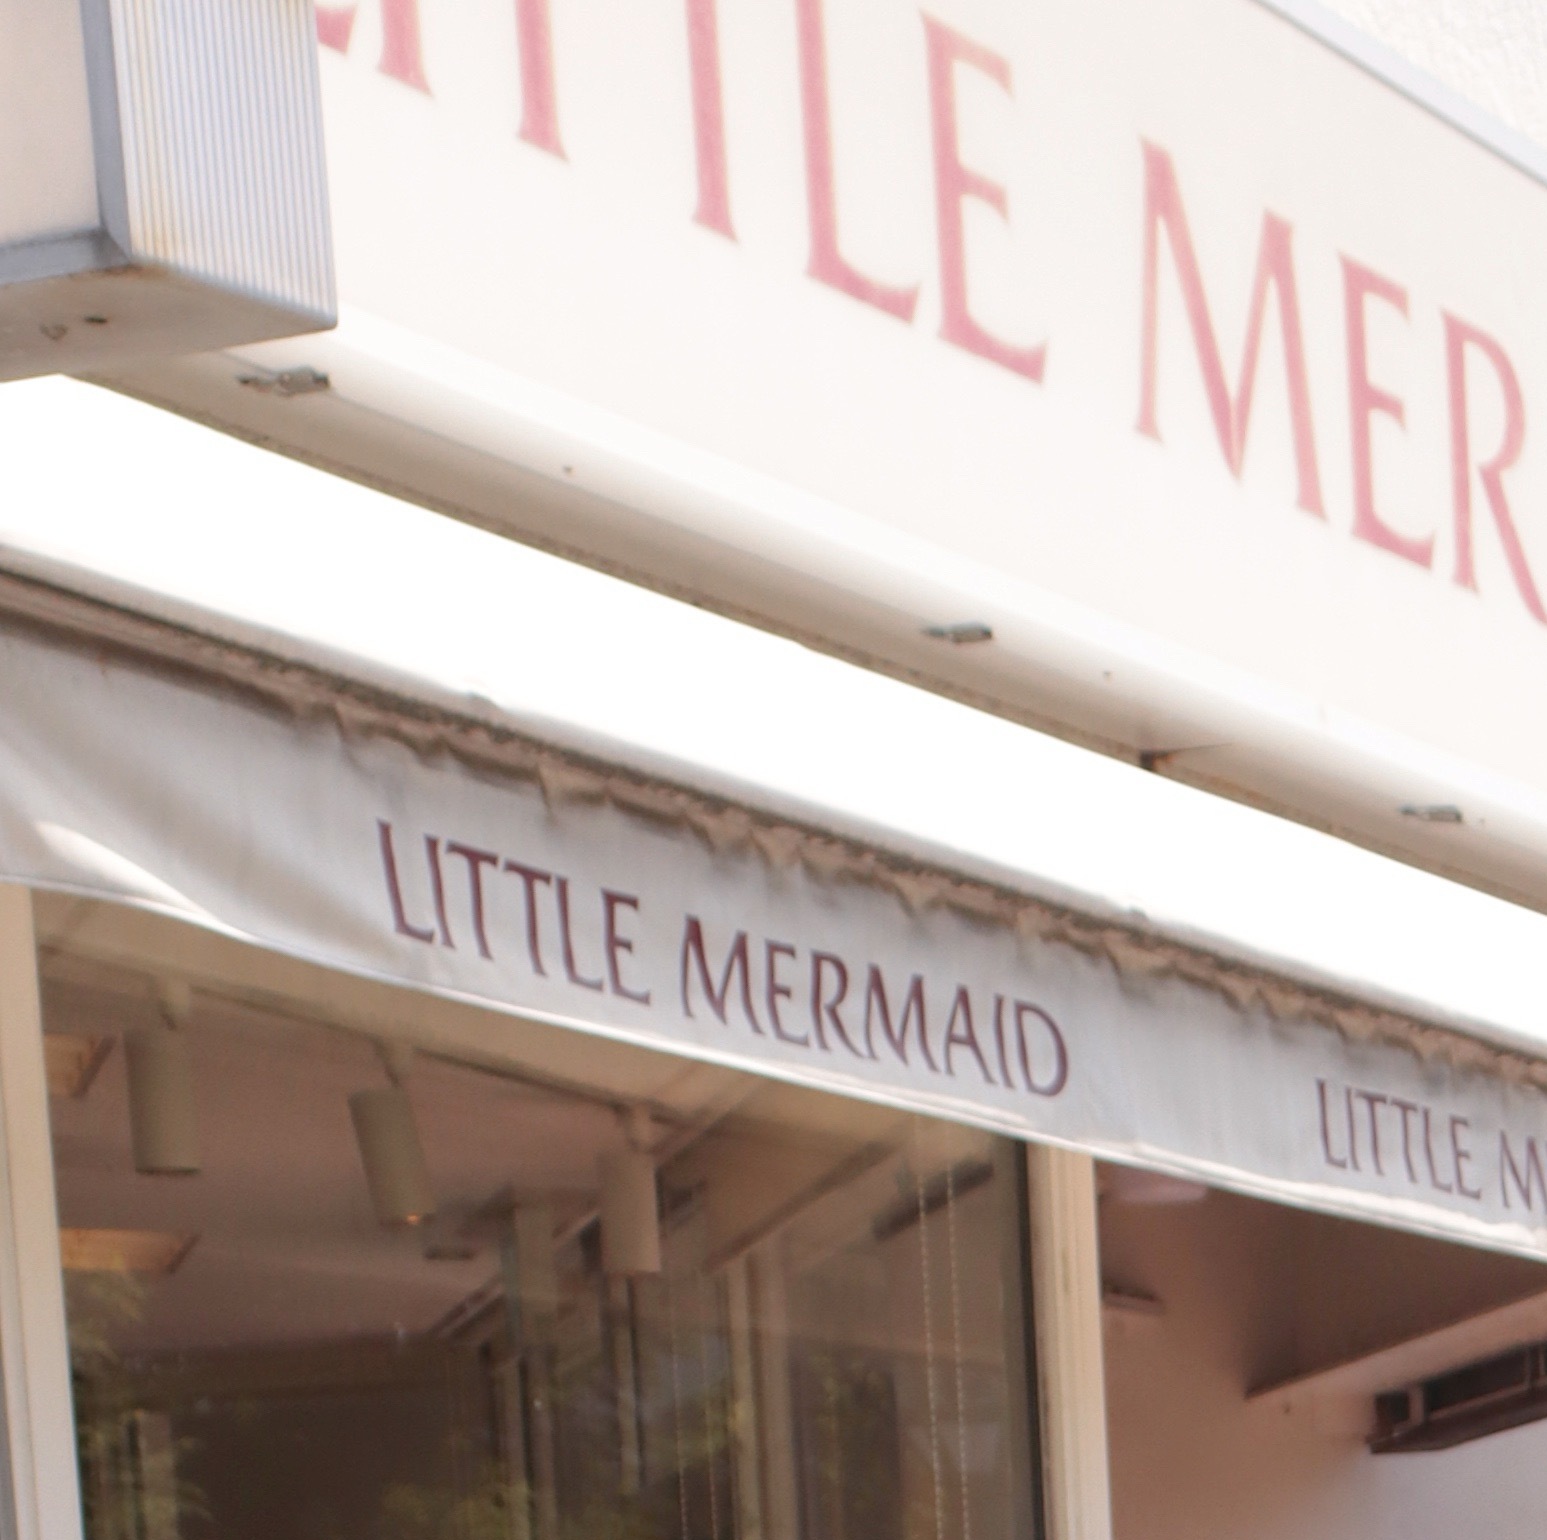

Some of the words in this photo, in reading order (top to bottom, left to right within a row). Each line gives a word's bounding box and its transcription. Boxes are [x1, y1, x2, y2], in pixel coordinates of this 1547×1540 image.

[376, 818, 652, 1005] LITTLE
[678, 915, 1069, 1099] MERMAID
[1315, 1078, 1482, 1200] LITTLE
